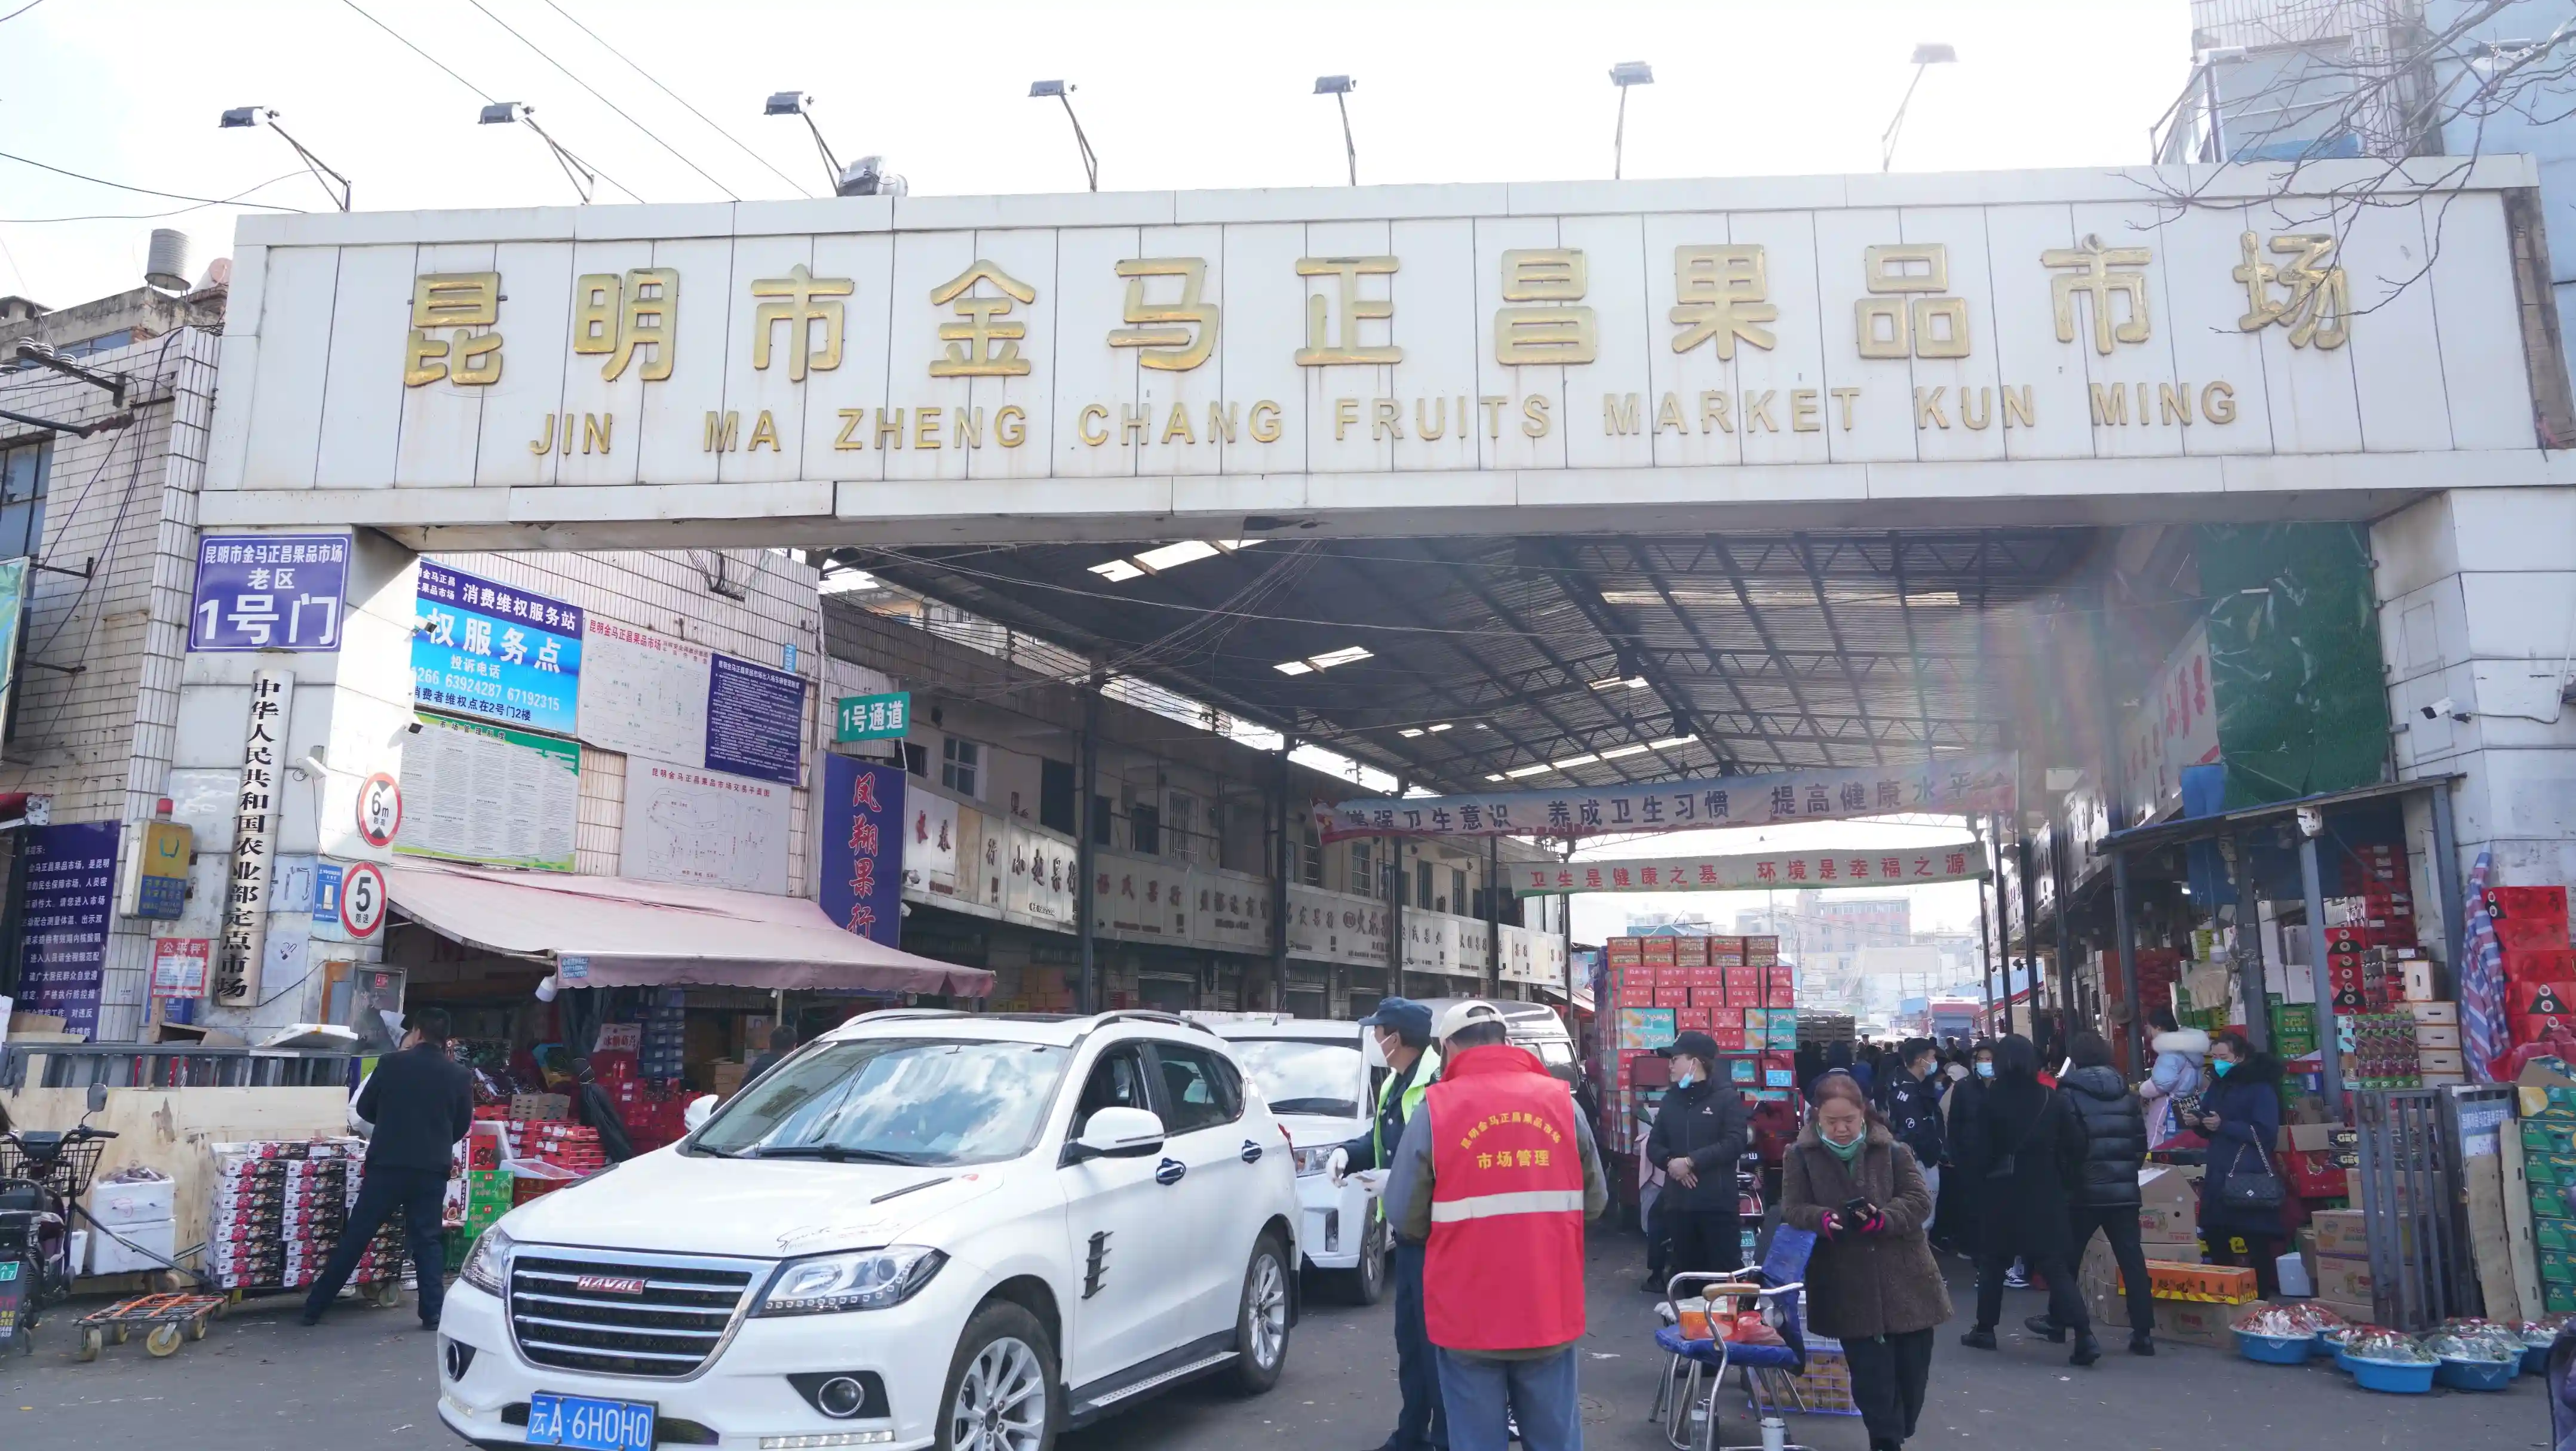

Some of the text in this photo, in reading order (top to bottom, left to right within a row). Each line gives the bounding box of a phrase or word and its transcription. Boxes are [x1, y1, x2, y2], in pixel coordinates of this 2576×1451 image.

[403, 230, 2350, 388] 昆明市金马正昌果品市场
[530, 380, 2237, 455] JIN MA ZHENG CHANG FRUITS MARKET KUN MING
[205, 544, 343, 564] 昆明市金马正昌果品市场
[247, 568, 295, 590] 老区
[198, 594, 337, 644] 1号门
[462, 583, 576, 631] 消费维权服务站
[589, 619, 661, 651] 昆明金马正昌果品市场
[450, 654, 501, 680] 投诉电话
[446, 674, 502, 699] 63924287
[508, 688, 560, 711] 67192315
[440, 720, 506, 740] 市场管理制度
[843, 700, 904, 733] 1号通道
[652, 768, 770, 798] 昆明金马正昌果品市场交易平面图
[1347, 771, 1972, 832] 增强卫生意识 养成卫生习惯 提高健康水平
[216, 680, 281, 996] 中华人民共和国农业部定点市场
[1531, 853, 1966, 888] 卫生是健康之基 环境是幸福之源
[355, 877, 371, 912] 5
[1461, 1112, 1561, 1149] 昆明金马正昌果品市场
[1477, 1149, 1550, 1169] 市场管理
[579, 1277, 641, 1292] HAVAL
